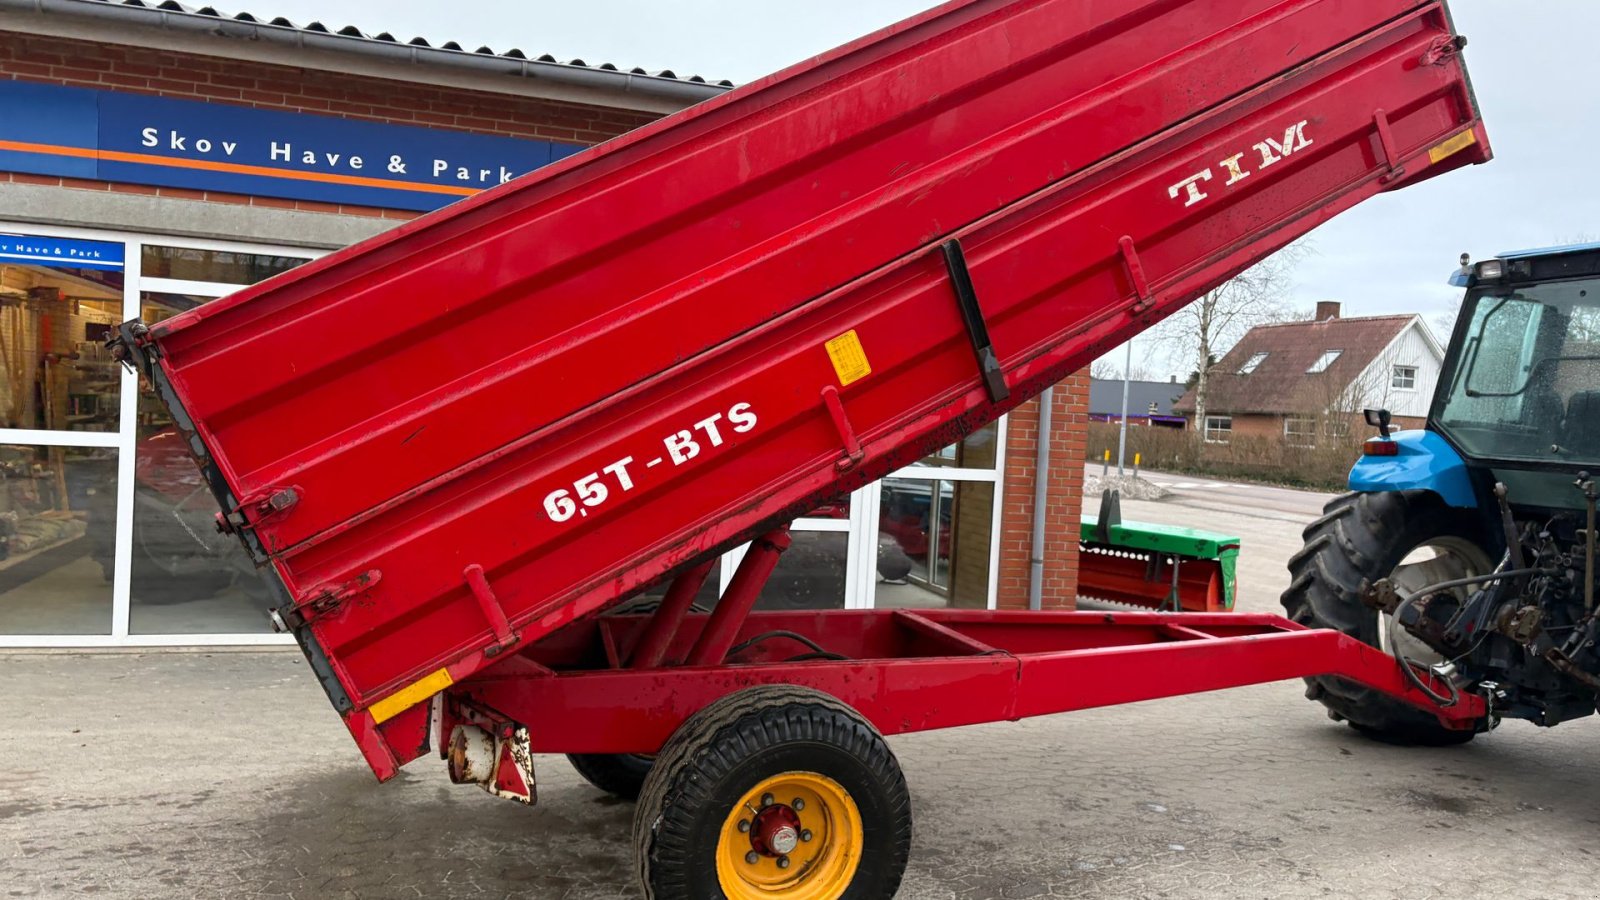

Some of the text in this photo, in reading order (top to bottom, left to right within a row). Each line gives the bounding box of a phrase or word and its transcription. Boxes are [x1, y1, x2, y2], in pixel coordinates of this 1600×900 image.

[141, 127, 513, 184] Skov Have & Park
[1167, 119, 1315, 208] TIM
[16, 244, 48, 254] Have
[54, 247, 62, 255] &
[70, 248, 100, 258] Park
